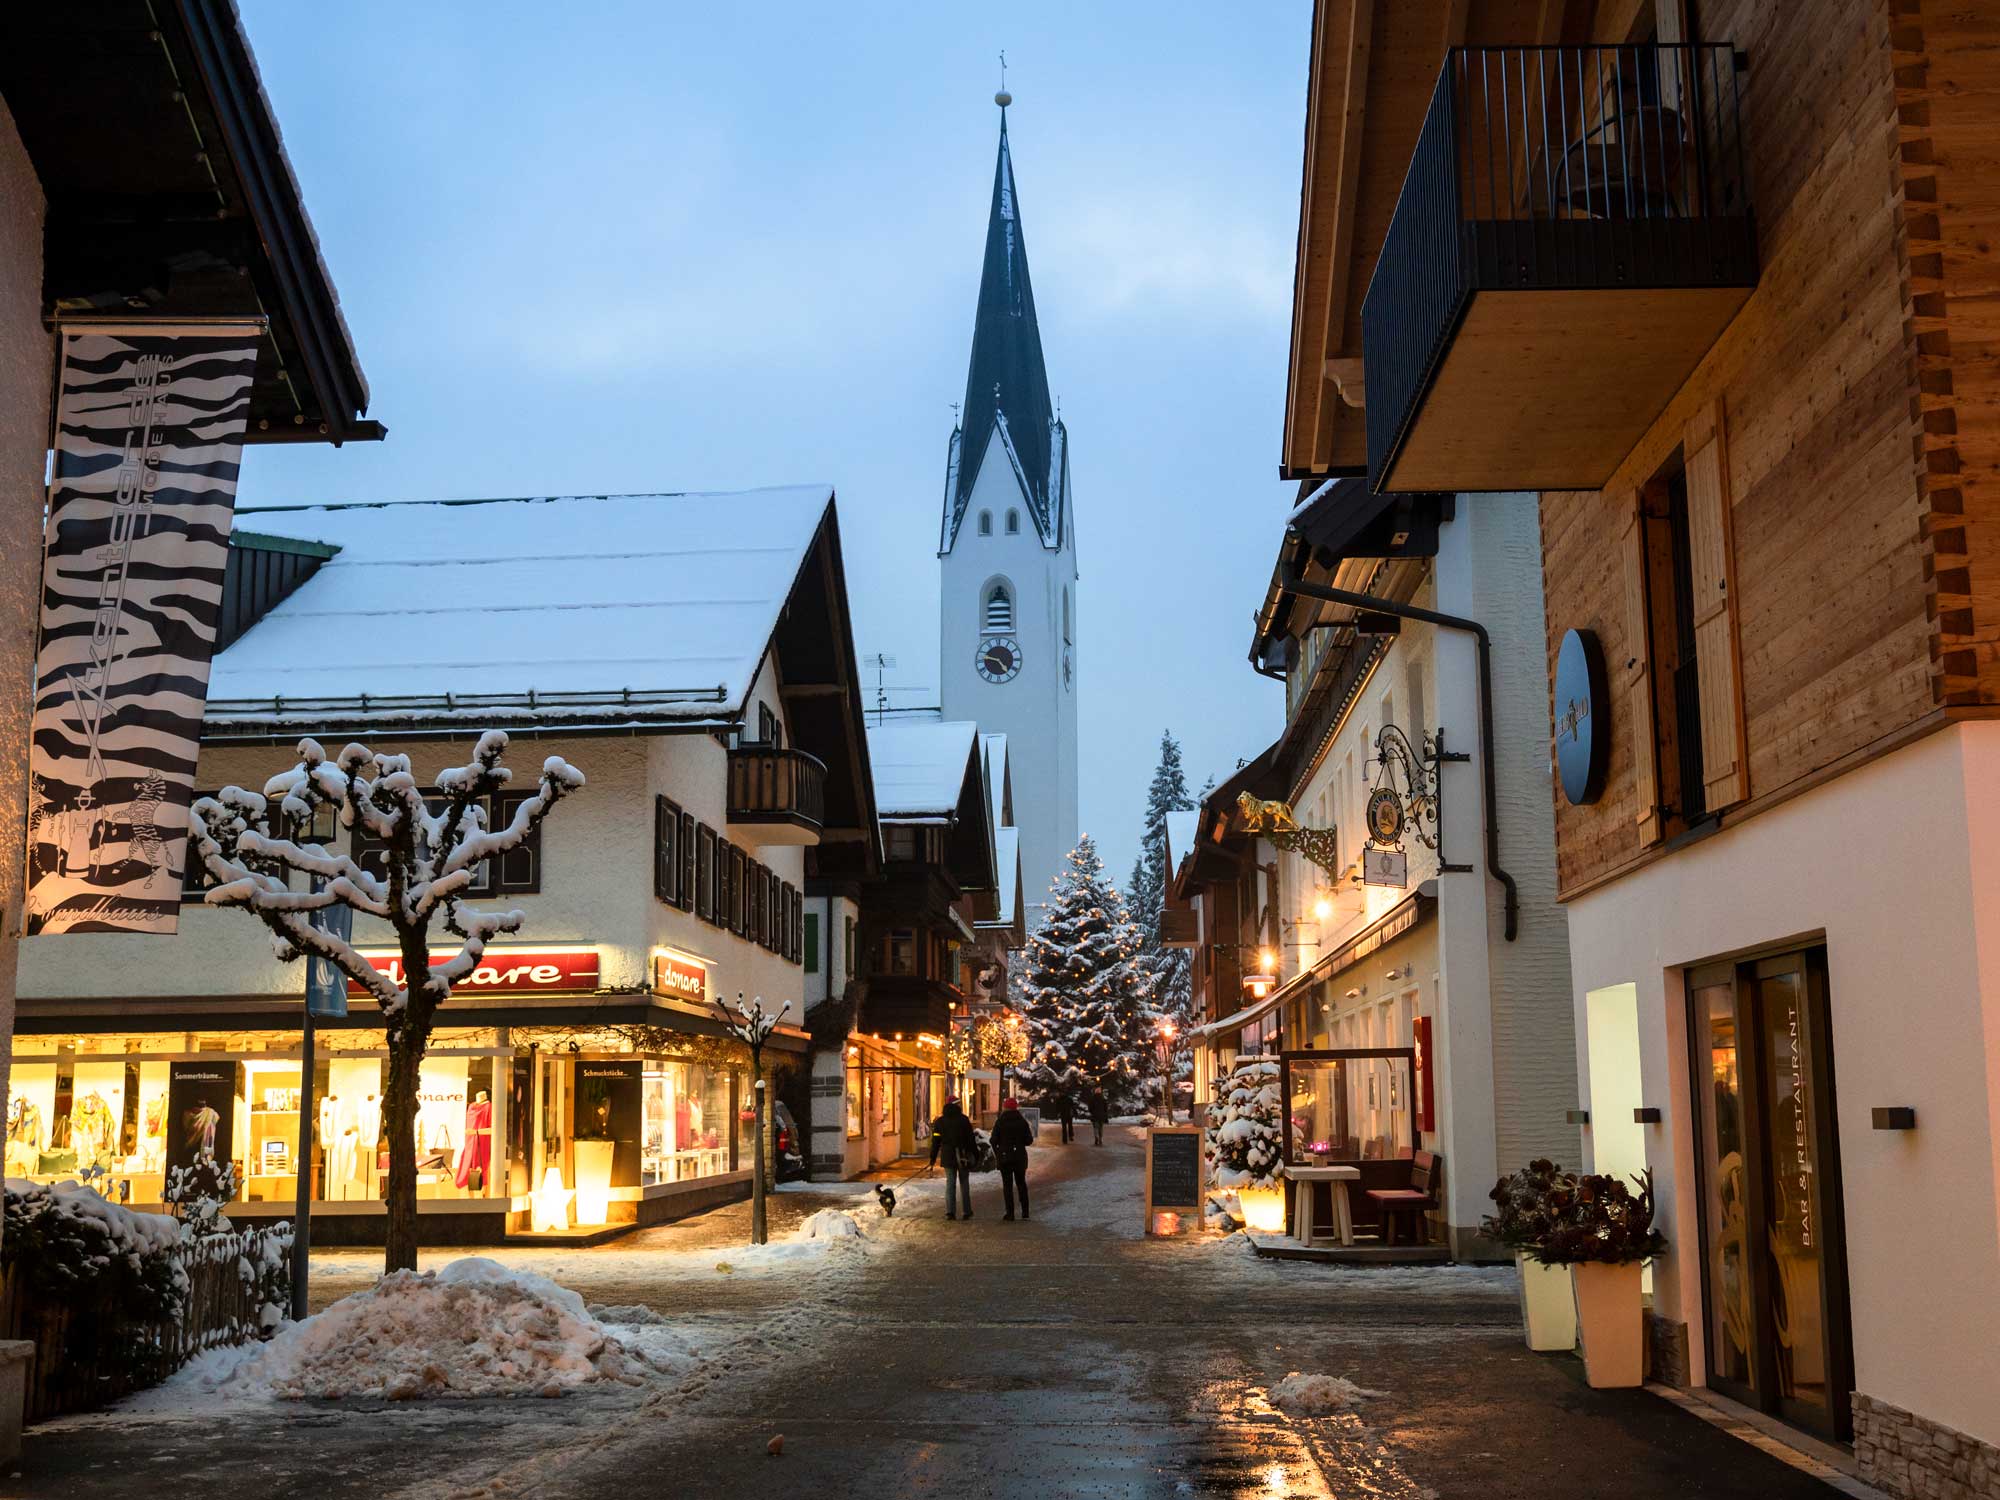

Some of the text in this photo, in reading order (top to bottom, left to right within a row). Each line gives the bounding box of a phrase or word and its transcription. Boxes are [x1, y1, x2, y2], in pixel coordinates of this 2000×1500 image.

[142, 354, 174, 509] MODEHAUS
[375, 960, 562, 986] dare
[664, 962, 700, 994] donare
[1788, 1007, 1811, 1247] BAR & RESTAURANT
